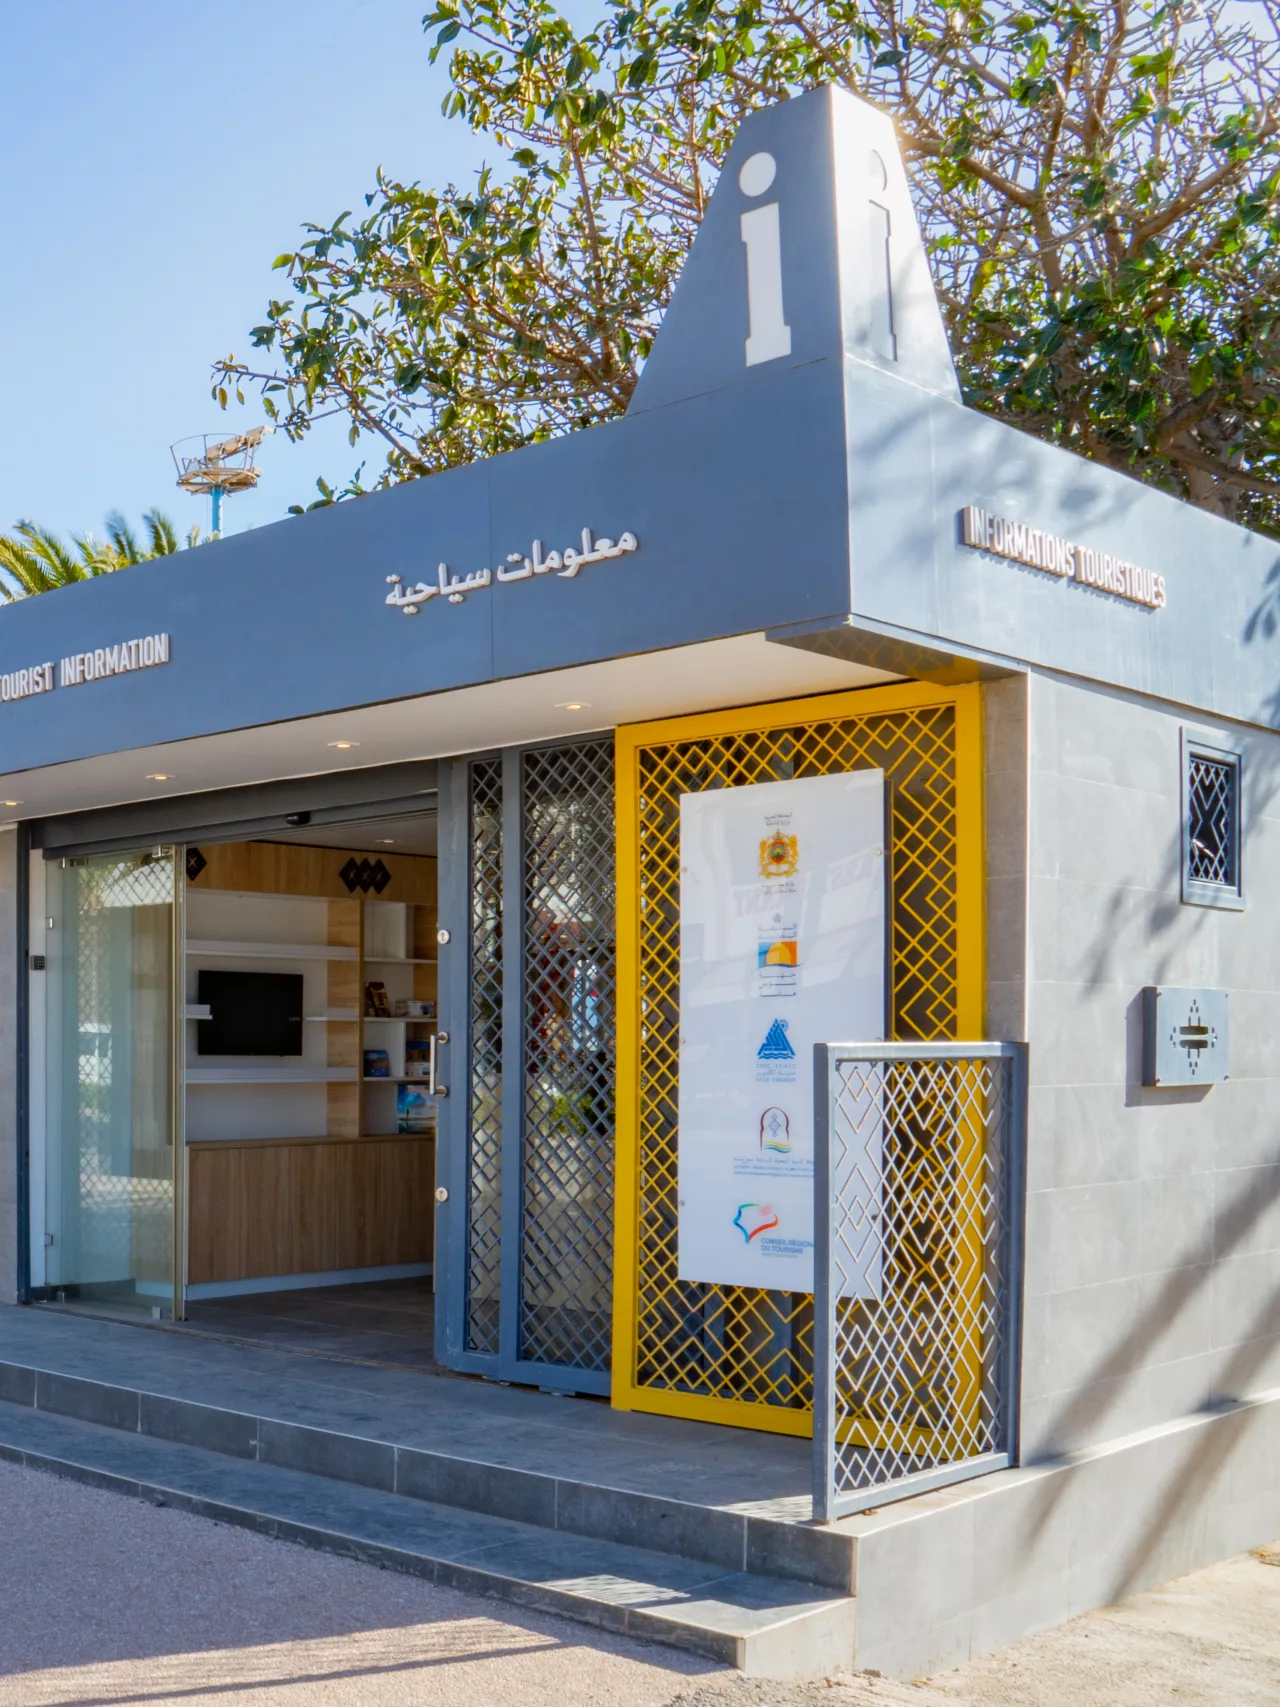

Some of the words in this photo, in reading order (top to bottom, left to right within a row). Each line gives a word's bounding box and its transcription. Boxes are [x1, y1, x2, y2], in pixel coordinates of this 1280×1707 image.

[496, 526, 638, 583] معلومات
[964, 505, 1076, 578] INFORMATIONS
[1075, 545, 1167, 609] TOURISTIQUES
[385, 562, 492, 615] سياحية
[60, 632, 170, 688] INFORMATION
[760, 1237, 786, 1246] CONSEIL
[760, 1244, 771, 1252] DU
[772, 1245, 804, 1254] TOURISME
